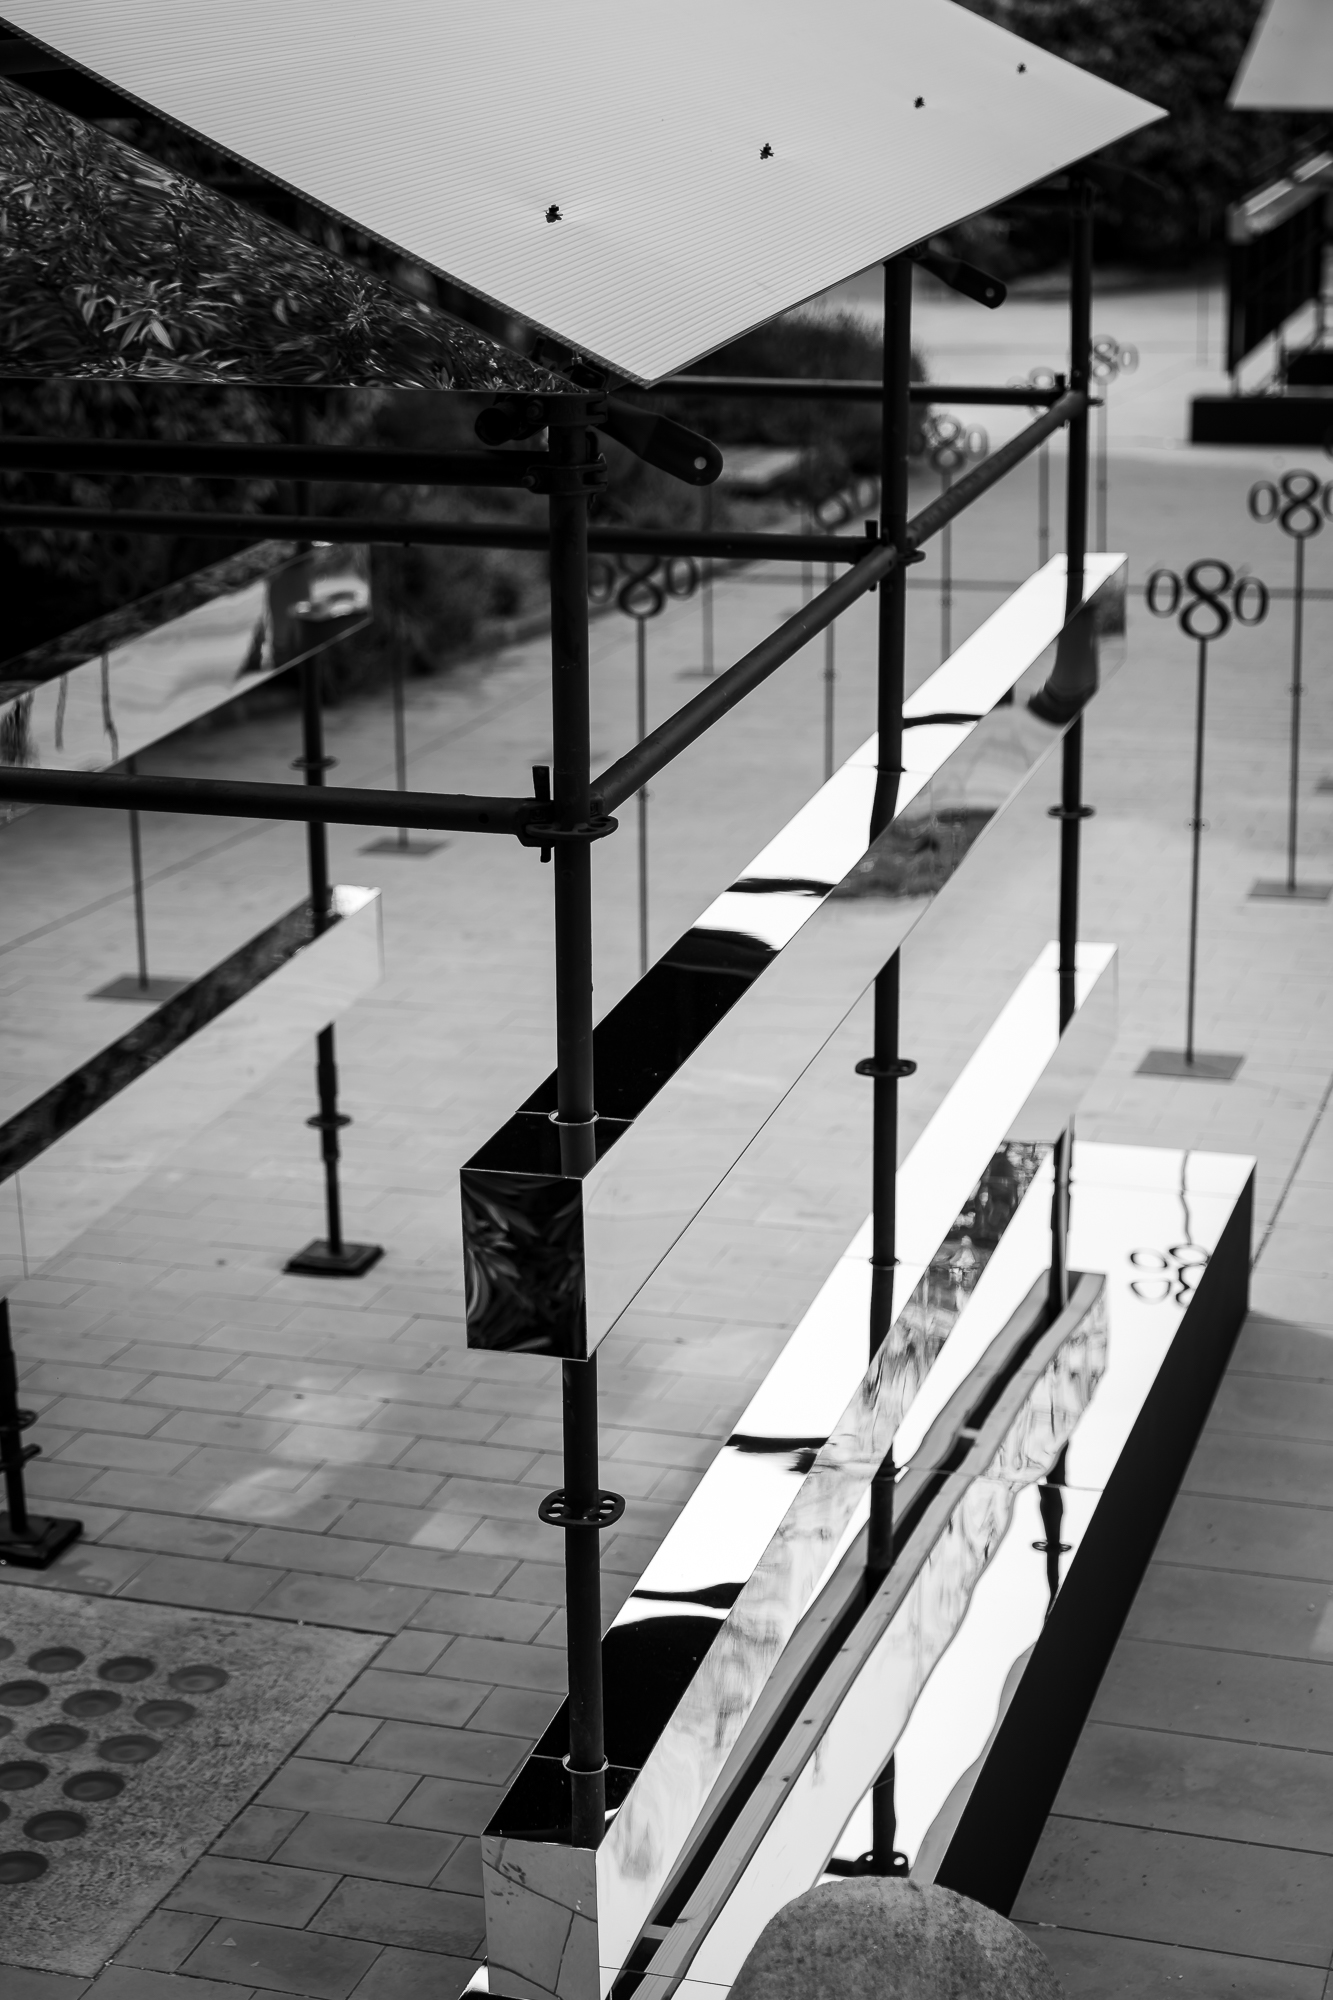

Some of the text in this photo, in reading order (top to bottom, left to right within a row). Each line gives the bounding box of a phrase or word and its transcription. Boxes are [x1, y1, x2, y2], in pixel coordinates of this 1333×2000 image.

[1091, 334, 1139, 386] 80
[1247, 469, 1333, 539] 080
[1145, 558, 1270, 641] 080
